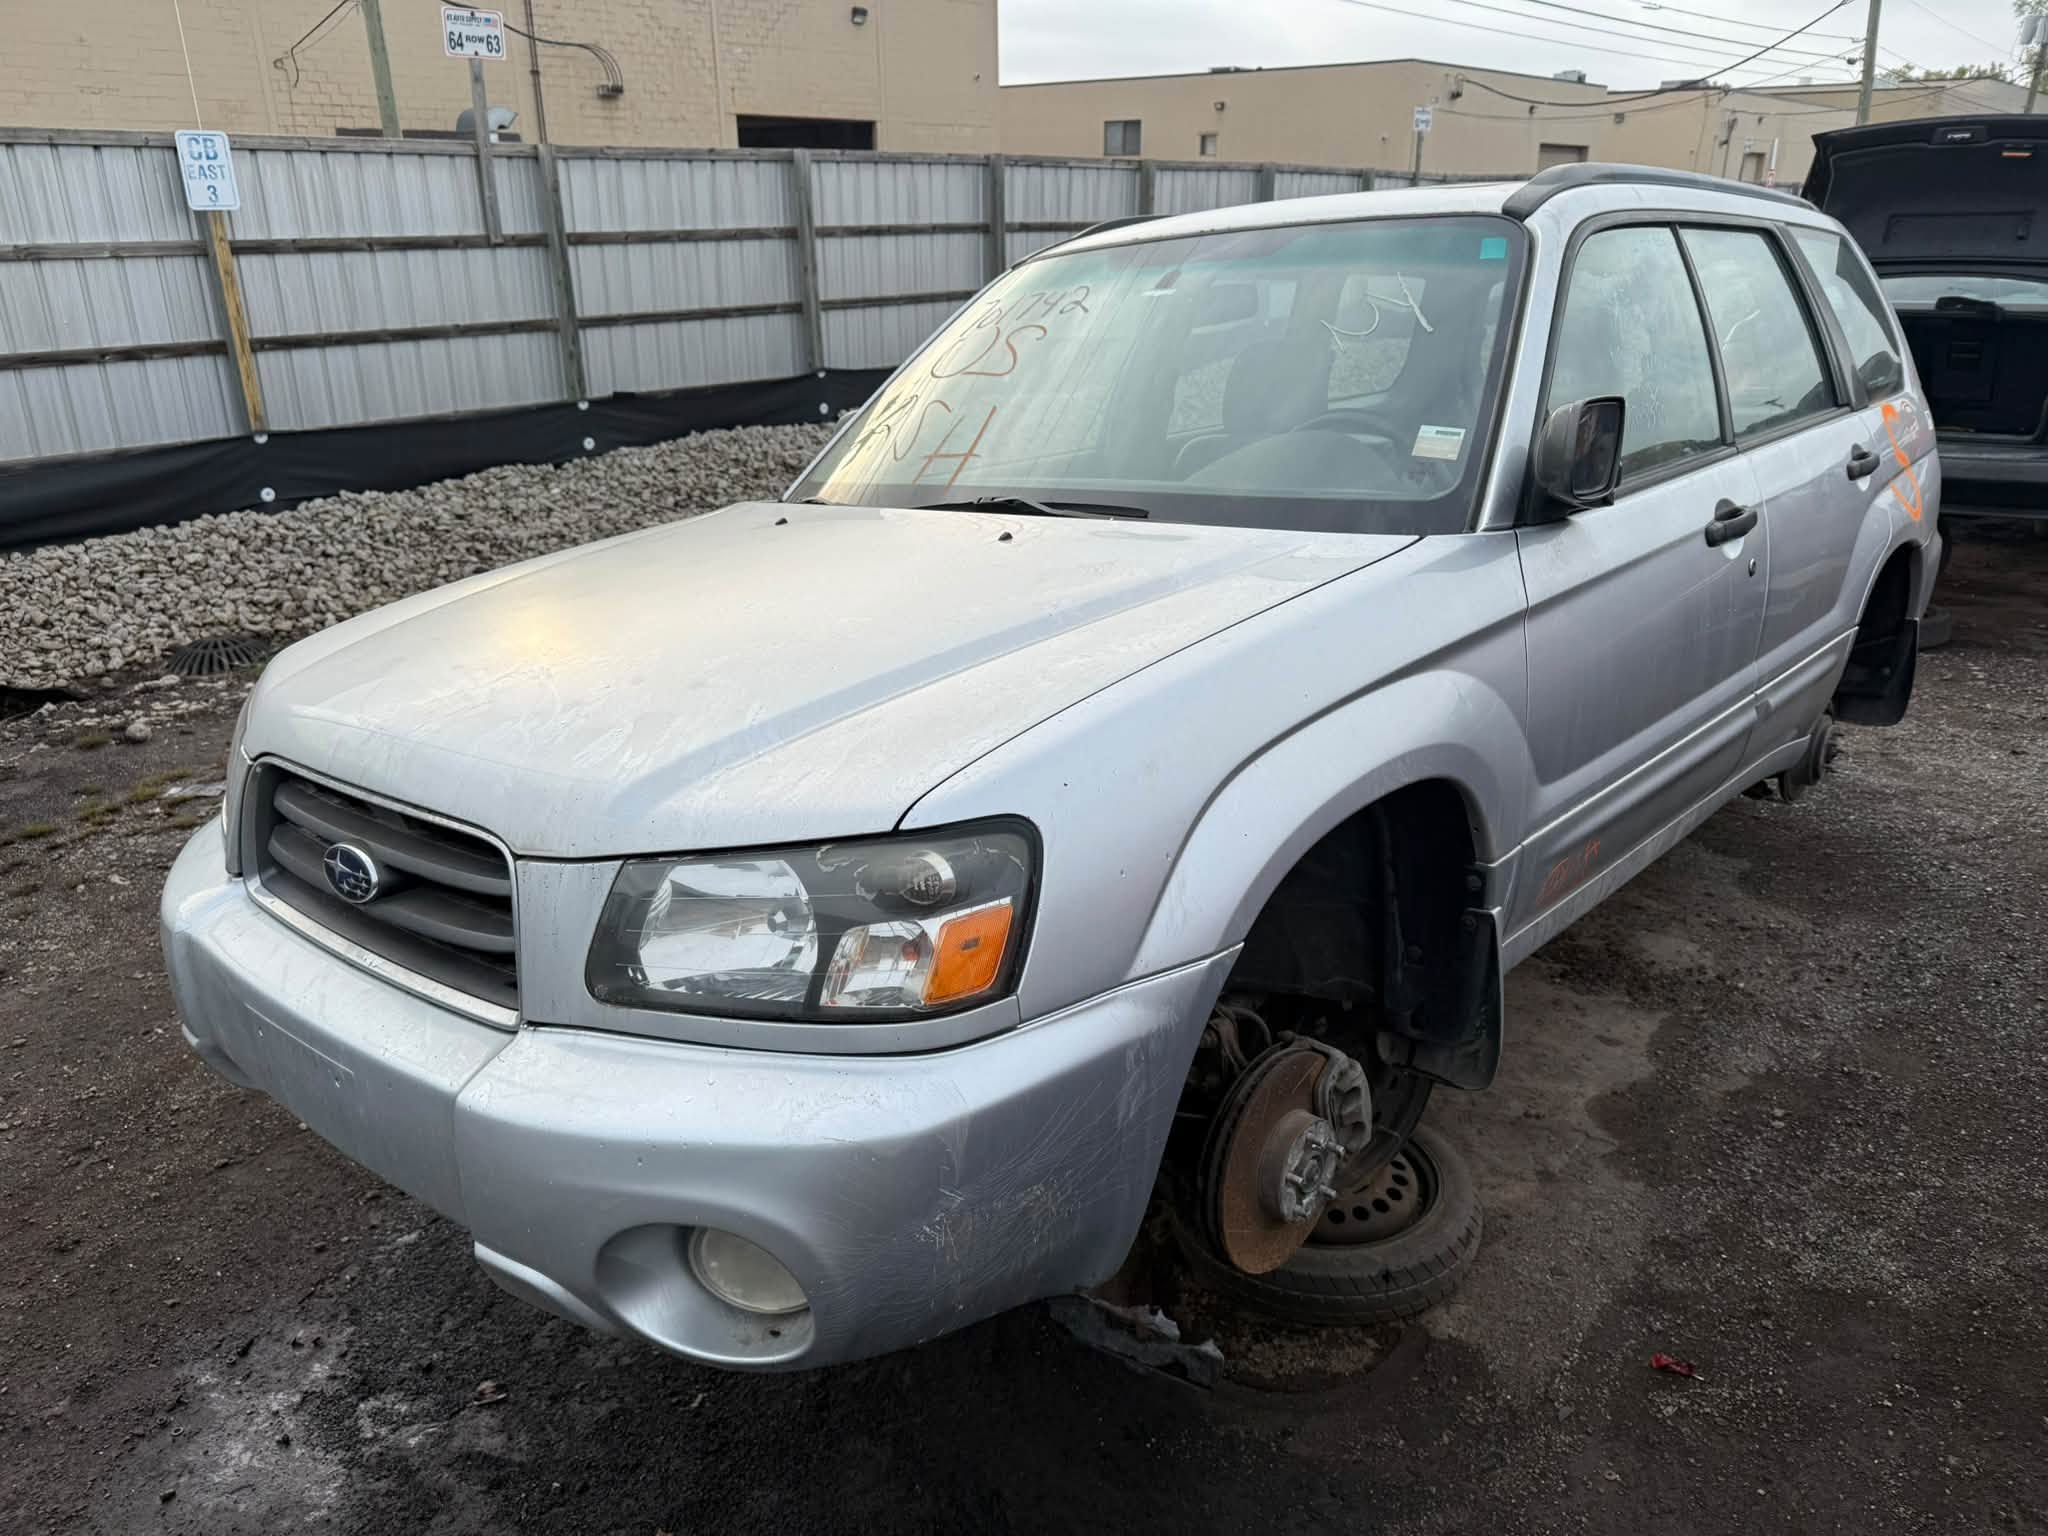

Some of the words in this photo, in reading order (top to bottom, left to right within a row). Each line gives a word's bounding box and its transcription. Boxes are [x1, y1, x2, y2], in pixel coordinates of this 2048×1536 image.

[448, 31, 464, 51] 64
[465, 34, 485, 44] ROW
[486, 34, 501, 54] 63
[187, 137, 218, 160] CB
[187, 164, 225, 180] EAST
[207, 185, 219, 203] 3
